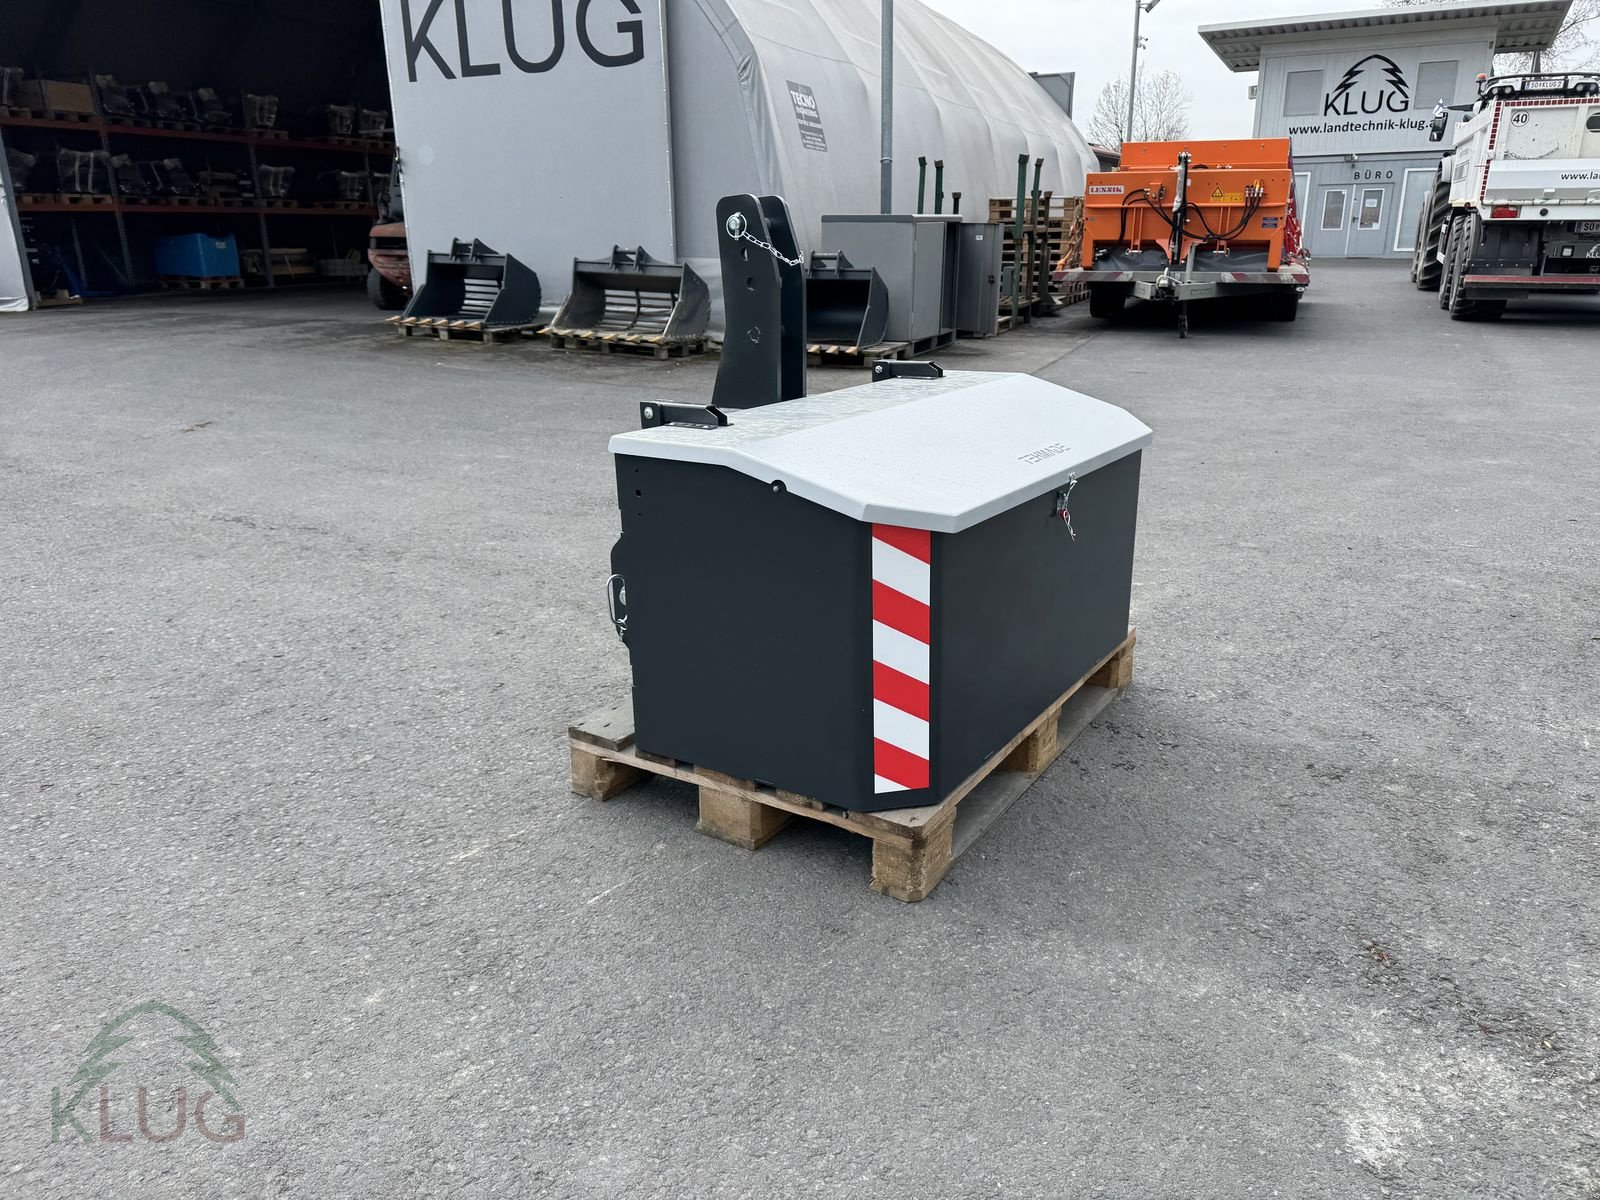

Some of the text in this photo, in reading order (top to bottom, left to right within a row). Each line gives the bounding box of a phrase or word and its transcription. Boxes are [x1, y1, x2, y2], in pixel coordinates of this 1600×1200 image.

[400, 0, 645, 82] KLUG
[1323, 90, 1409, 117] KLUG
[1288, 117, 1435, 135] www.landtechnik-klug.a
[1513, 114, 1528, 124] 40
[1353, 169, 1393, 180] BÜRO
[1561, 171, 1600, 180] www.la
